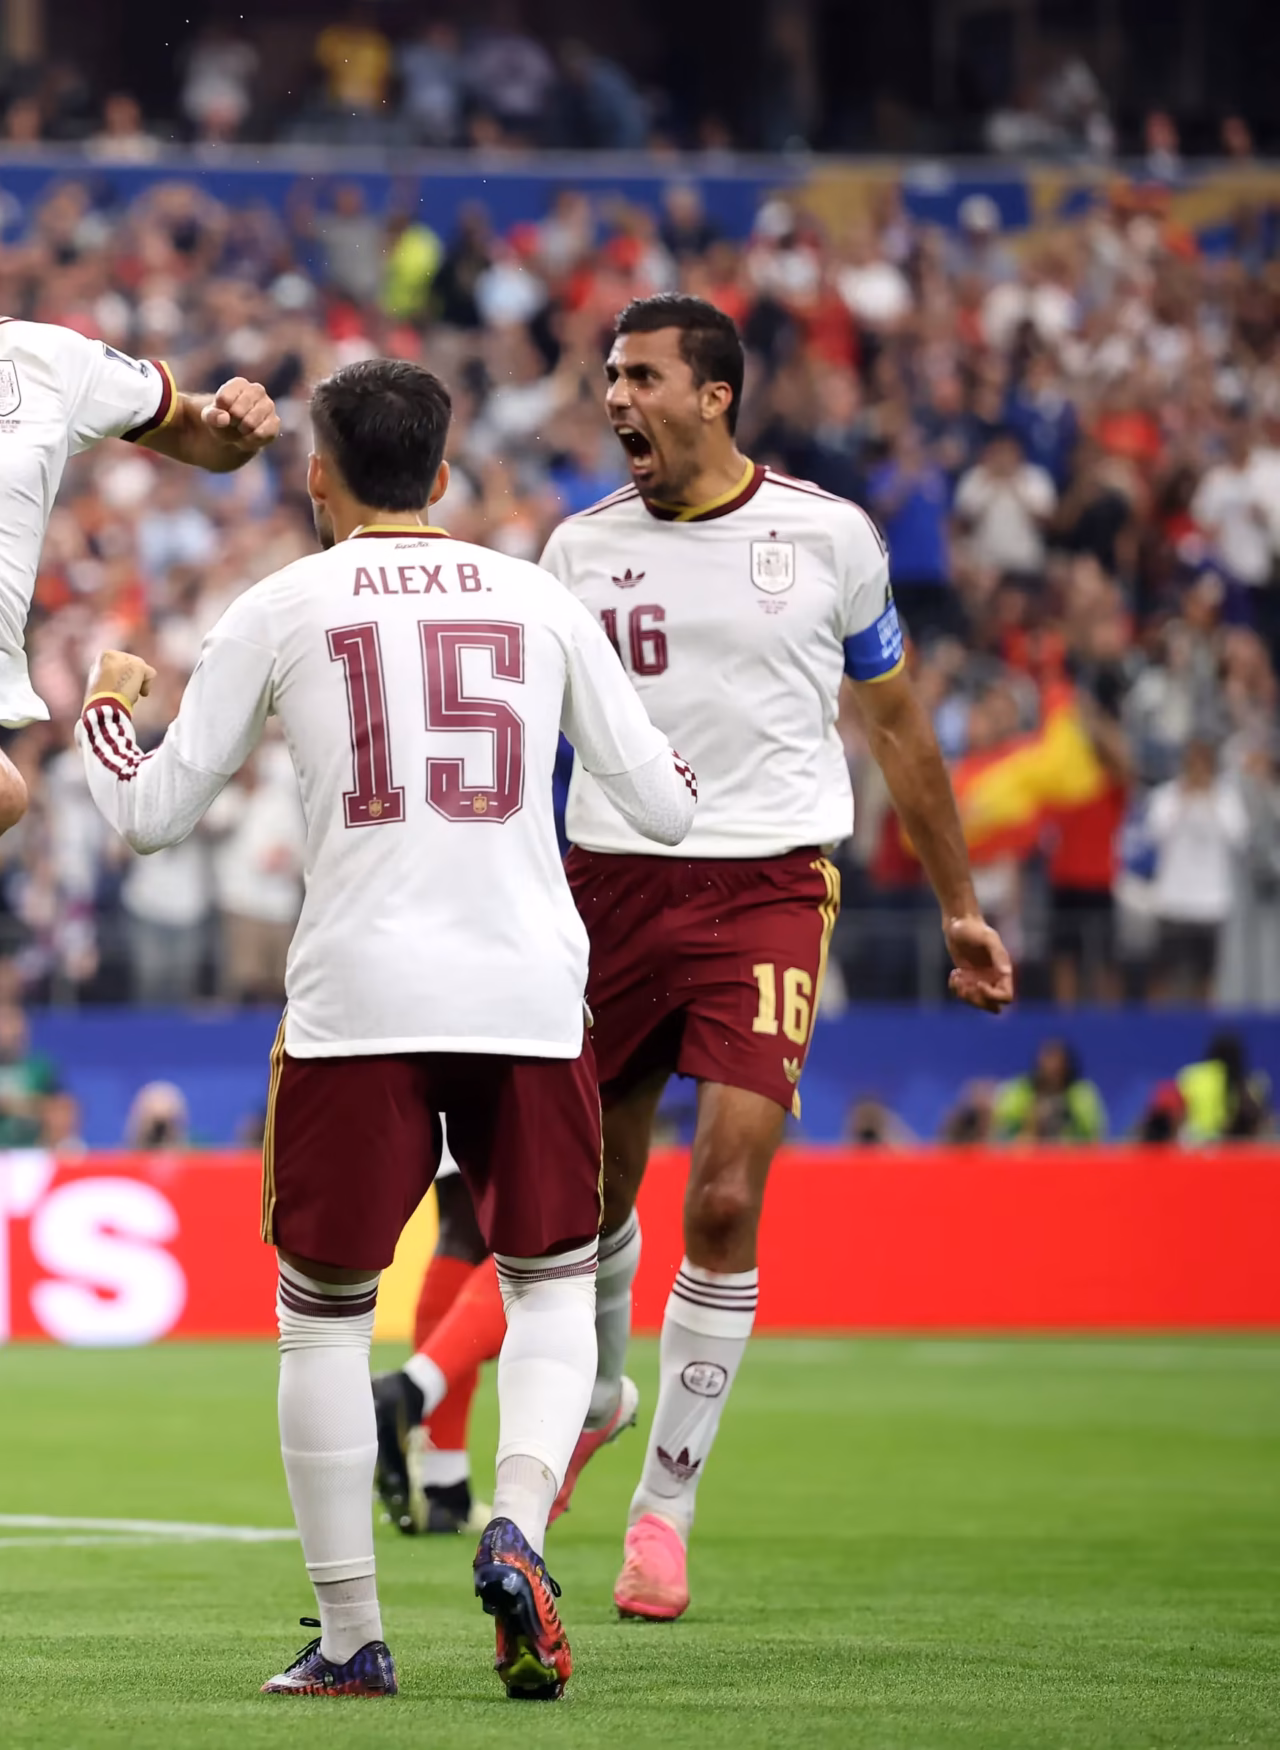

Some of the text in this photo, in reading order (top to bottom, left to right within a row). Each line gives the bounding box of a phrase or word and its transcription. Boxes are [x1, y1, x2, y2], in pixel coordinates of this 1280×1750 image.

[353, 563, 492, 596] ALEX B.
[600, 604, 668, 677] 16
[325, 619, 525, 829] 15
[752, 963, 812, 1046] 16
